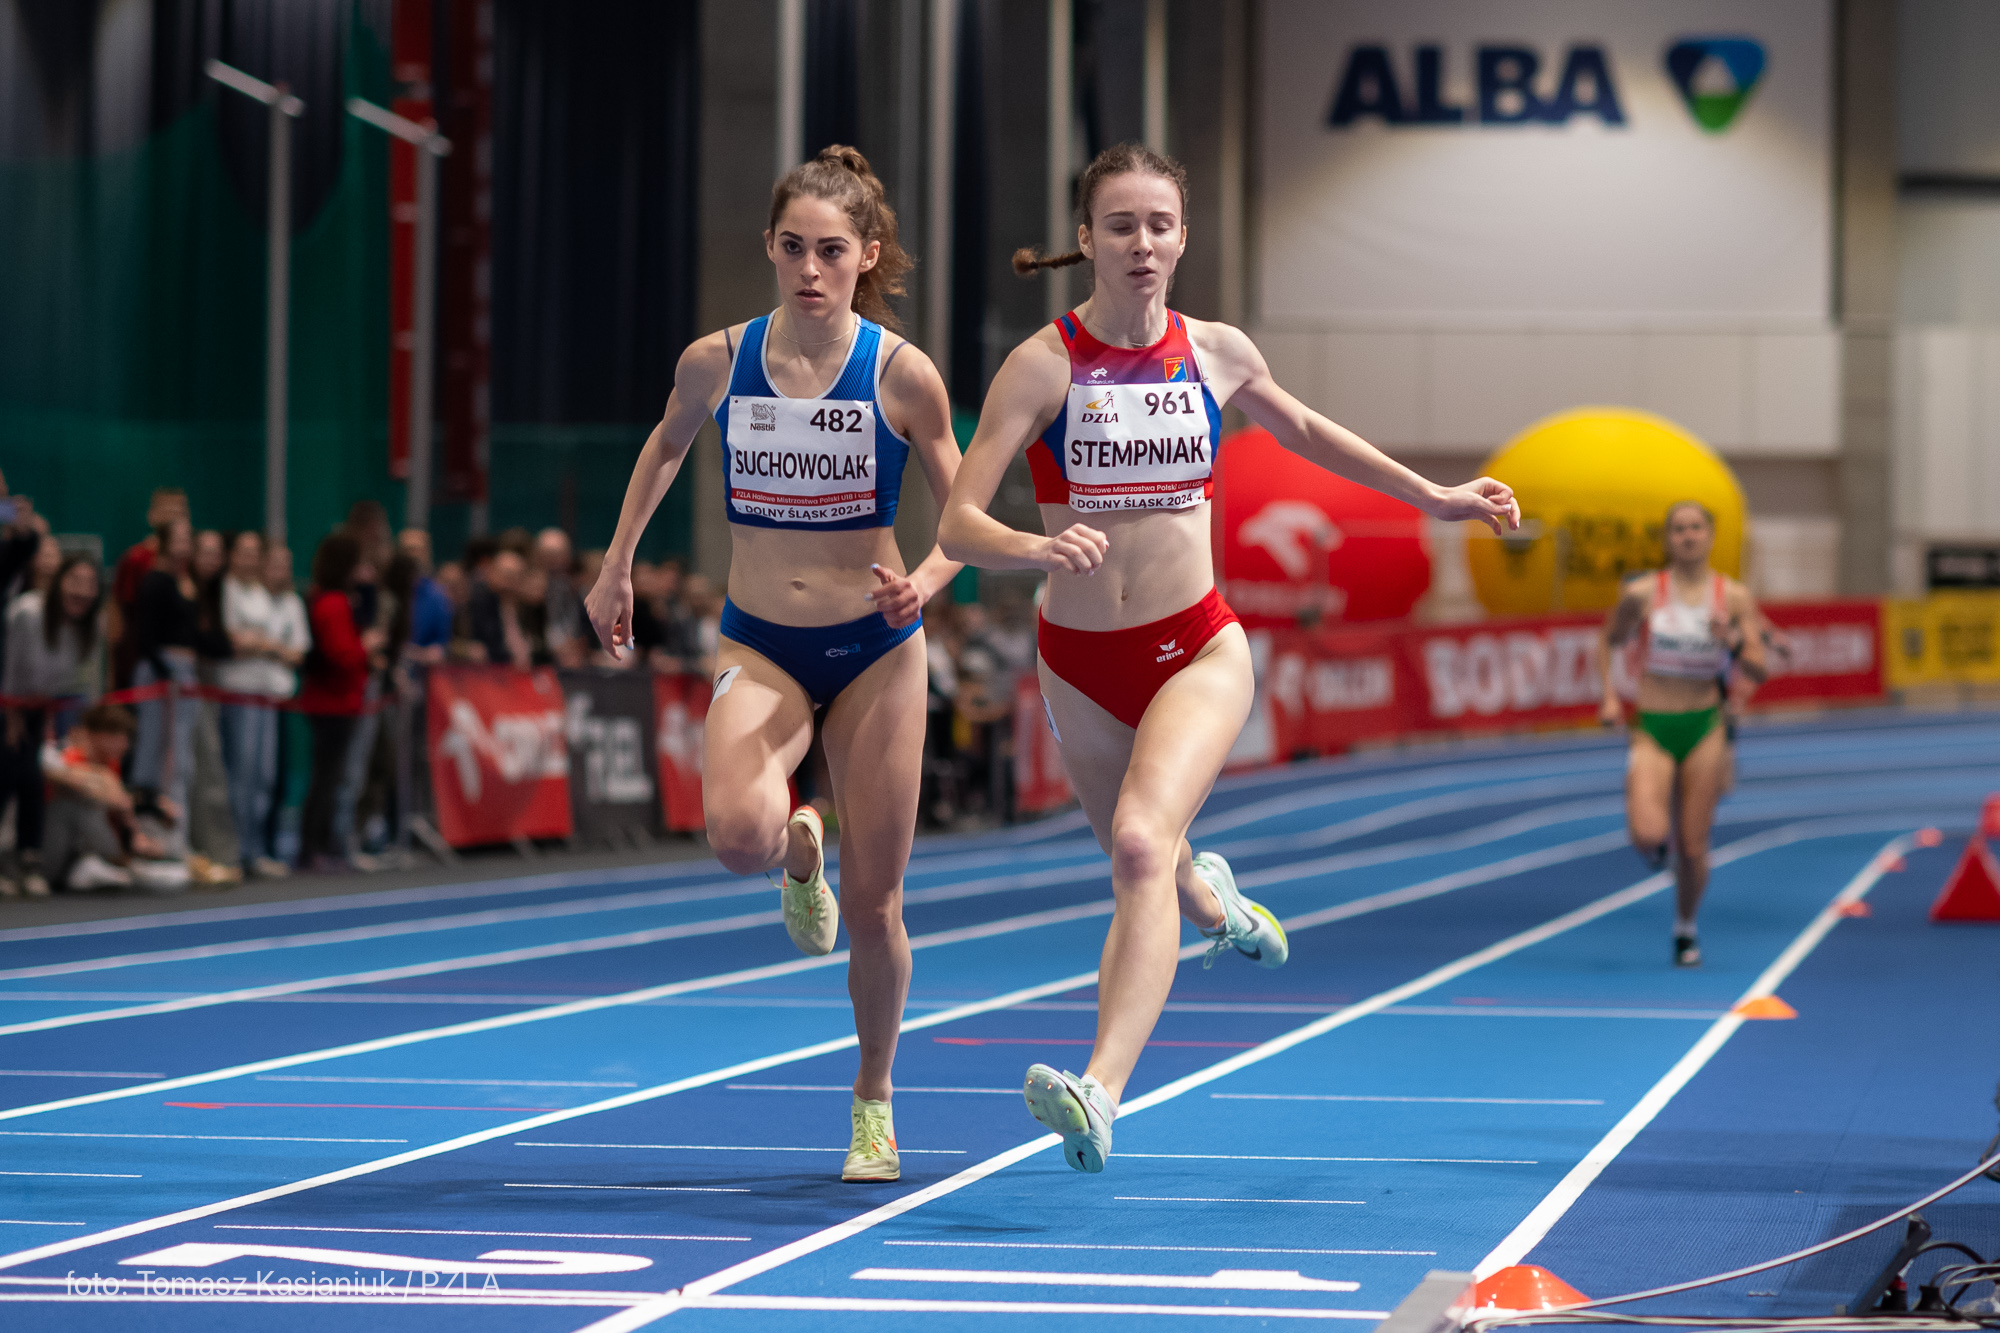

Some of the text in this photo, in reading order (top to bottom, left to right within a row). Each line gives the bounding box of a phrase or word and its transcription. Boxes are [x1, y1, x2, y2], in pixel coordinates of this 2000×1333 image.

[1328, 44, 1627, 126] ALBA
[1144, 391, 1195, 416] 961
[810, 408, 863, 433] 482
[1081, 412, 1119, 424] DZLA
[1070, 436, 1206, 468] STEMPNIAK
[735, 450, 869, 481] SUCHOWOLAK
[1069, 483, 1083, 493] PZLA
[1084, 486, 1112, 494] Halowe
[1112, 485, 1156, 493] Mistrzostwa
[1156, 483, 1177, 492] Polski
[736, 490, 751, 499] PZLA
[752, 493, 776, 503] Halowe
[776, 496, 819, 505] Mistrzostwa
[819, 495, 840, 504] Polski
[841, 493, 853, 501] U18
[858, 491, 872, 499] U20
[1077, 493, 1193, 509] DOLNY ŚLĄSK 2024
[745, 504, 862, 520] DOLNY ŚLĄSK 2024
[1156, 648, 1185, 663] erima
